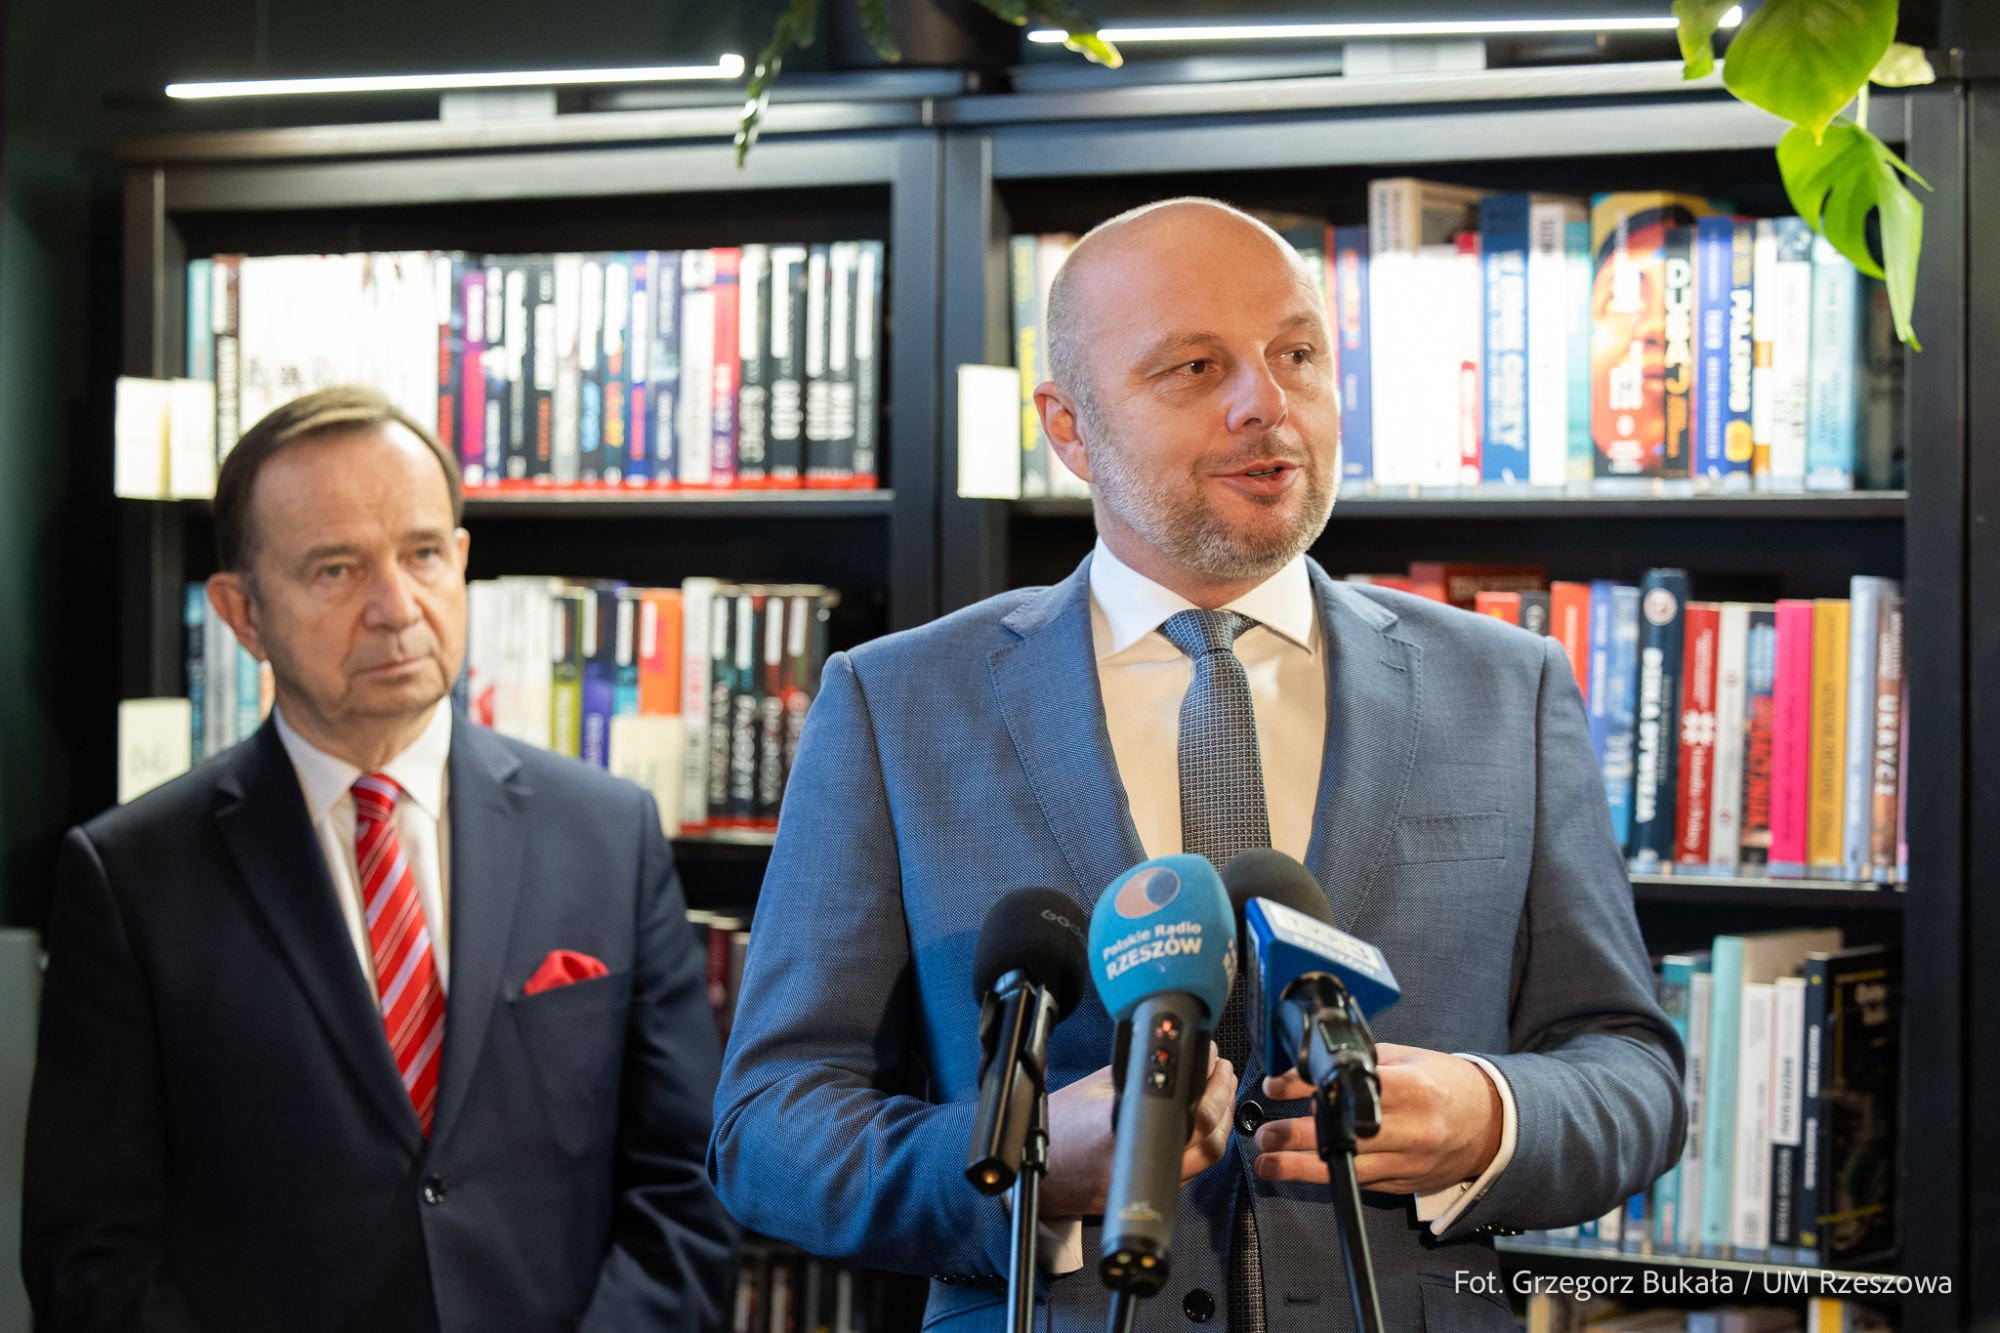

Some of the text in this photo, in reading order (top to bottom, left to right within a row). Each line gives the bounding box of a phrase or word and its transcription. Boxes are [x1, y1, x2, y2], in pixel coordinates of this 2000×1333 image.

[1102, 921, 1202, 960] Polskie Radio
[1106, 933, 1203, 981] RZESZÓW
